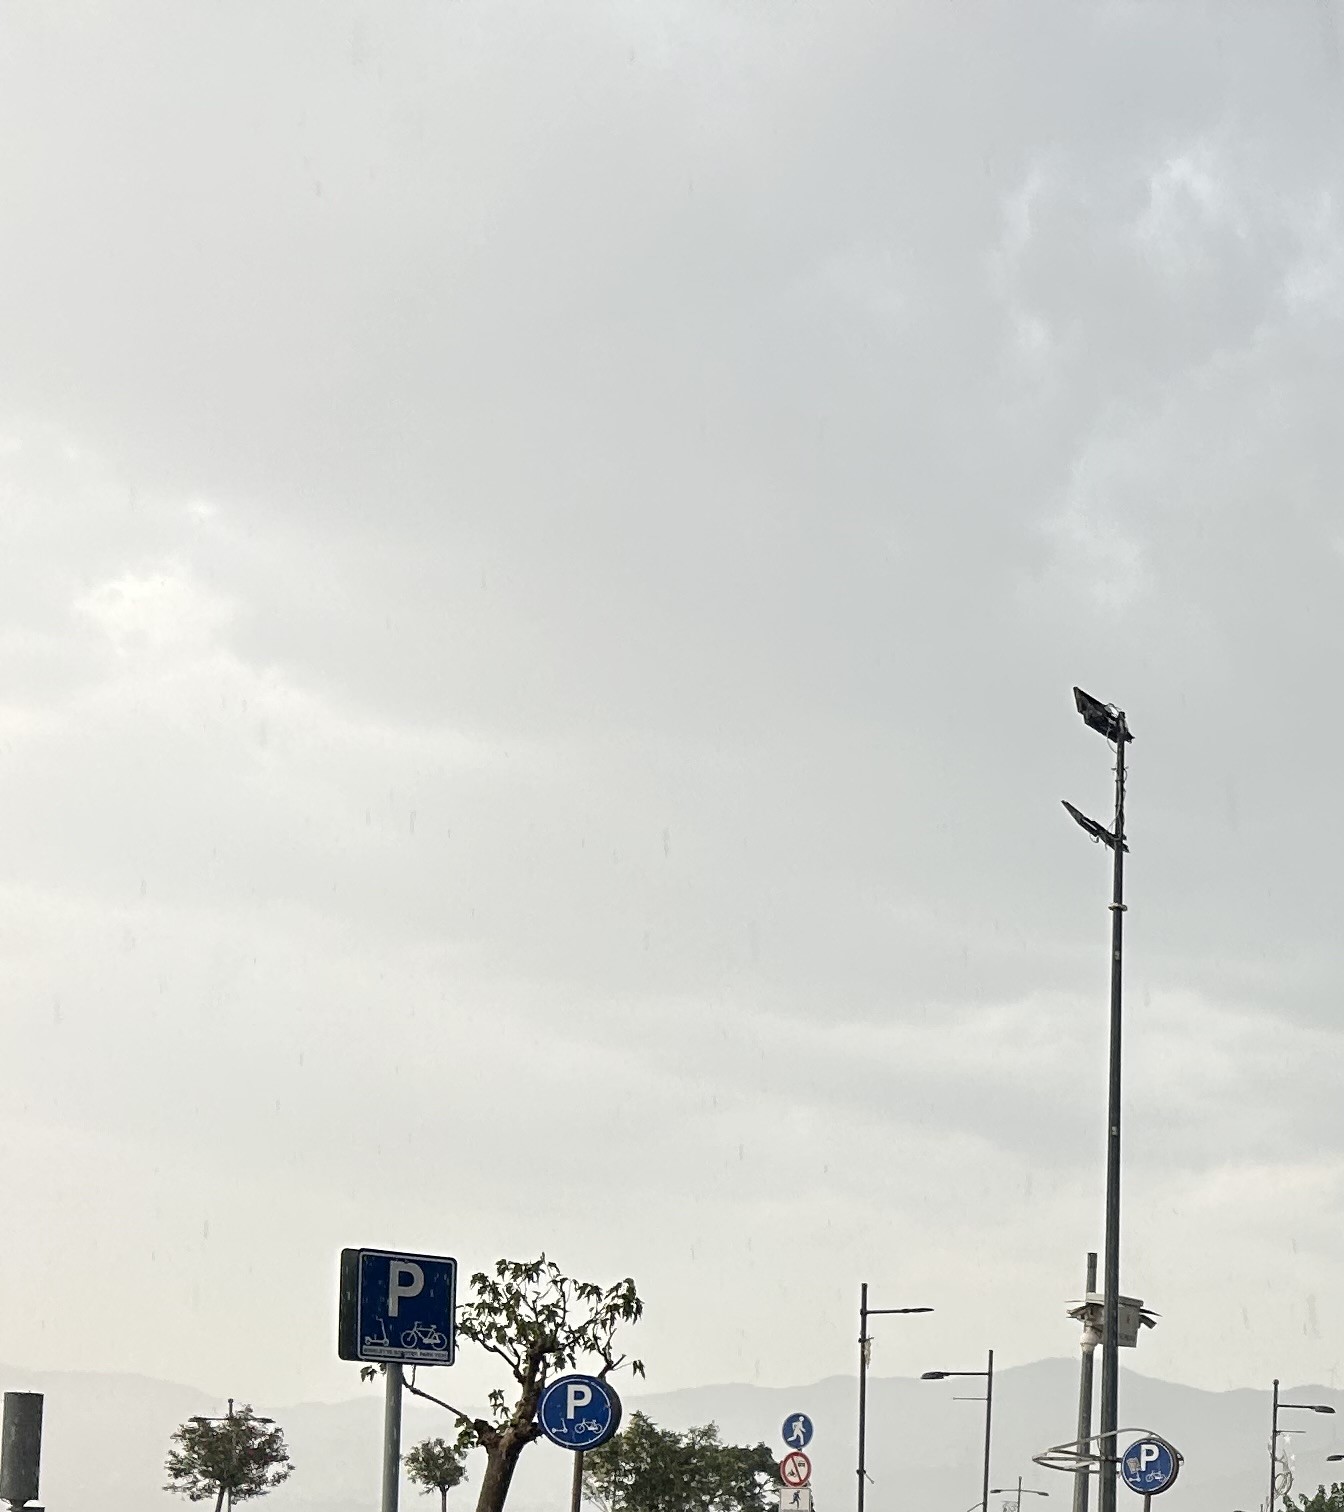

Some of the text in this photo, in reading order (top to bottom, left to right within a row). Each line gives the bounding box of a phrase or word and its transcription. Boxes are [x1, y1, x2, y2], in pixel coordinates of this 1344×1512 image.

[388, 1260, 424, 1317] P
[566, 1384, 592, 1420] P
[1140, 1444, 1160, 1471] P
